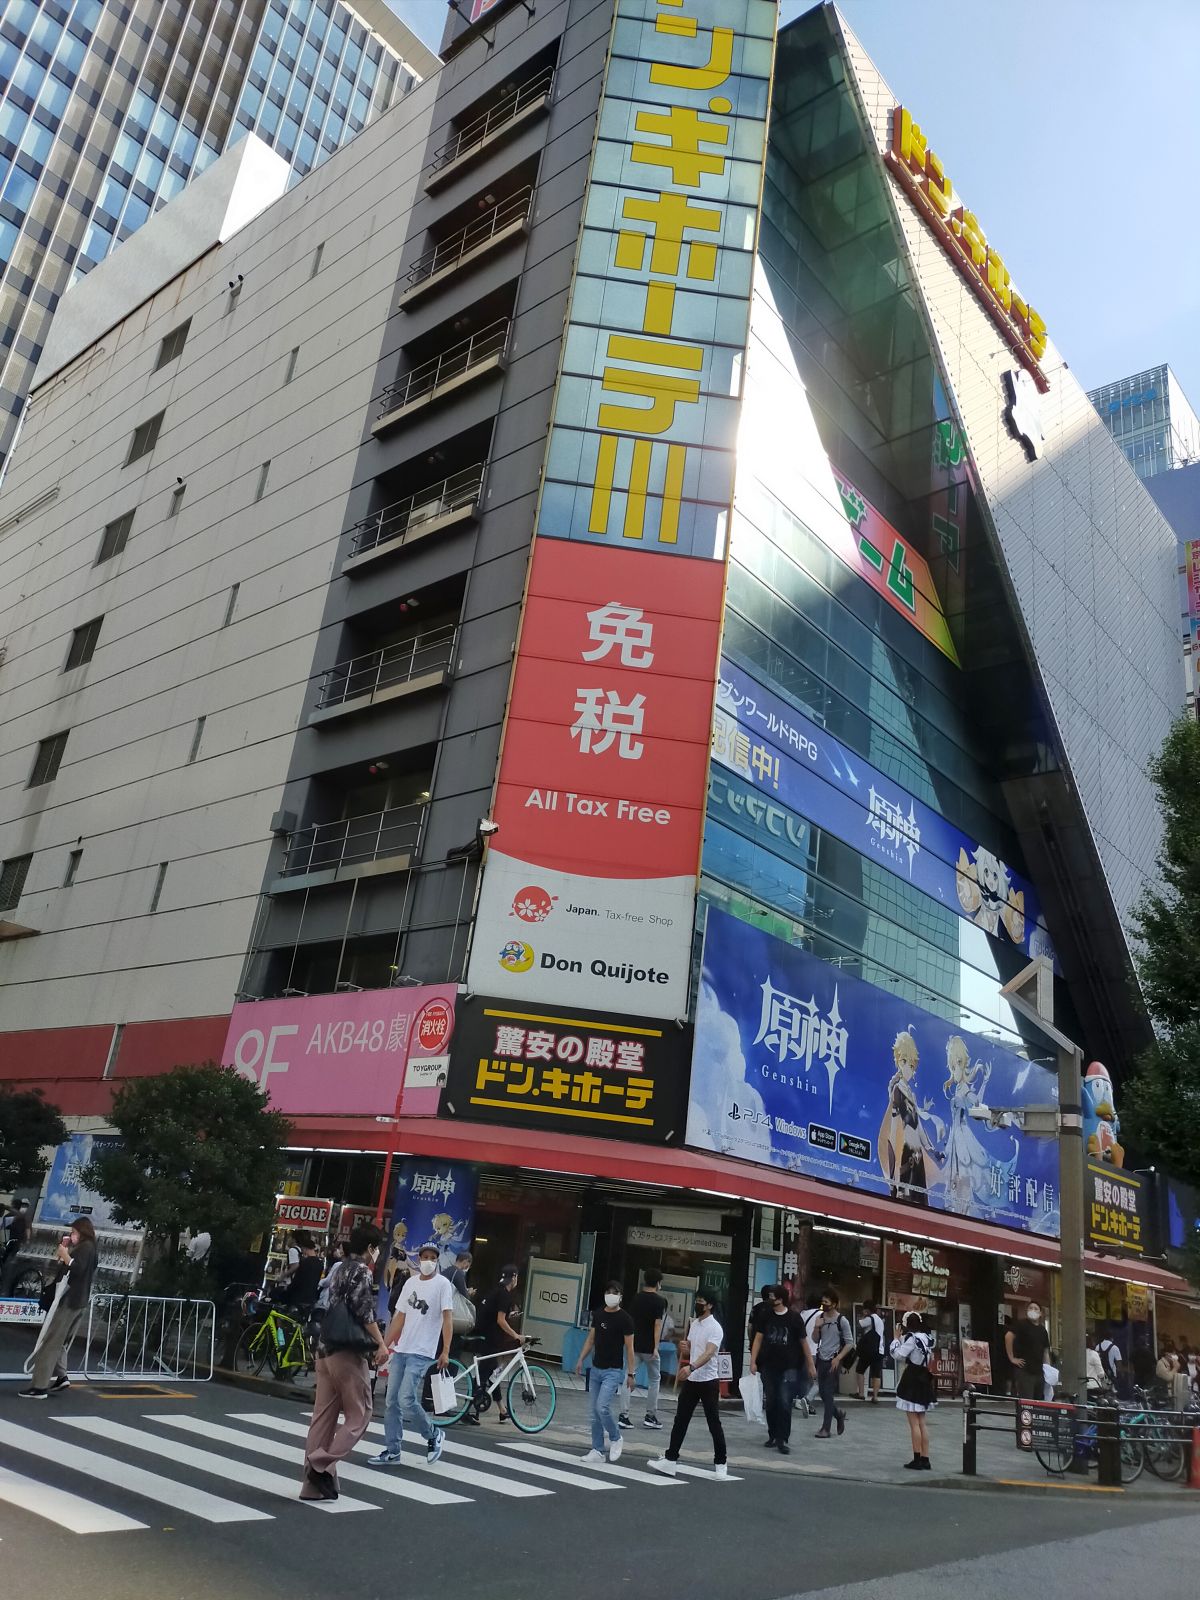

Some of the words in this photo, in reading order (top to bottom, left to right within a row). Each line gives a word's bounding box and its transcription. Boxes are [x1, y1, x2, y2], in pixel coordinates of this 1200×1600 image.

[570, 601, 655, 760] 免税
[525, 789, 558, 810] All
[566, 793, 608, 816] Tax
[617, 800, 671, 825] Free
[870, 837, 904, 864] Genshin
[605, 909, 644, 923] Tax-free
[648, 914, 674, 927] Shop
[540, 952, 583, 973] Don
[590, 960, 670, 985] Quijote
[306, 1011, 419, 1056] AKB48劇
[421, 1019, 446, 1036] 消火栓
[494, 1025, 645, 1072] 驚安の殿堂
[761, 1064, 818, 1095] Genshin
[775, 1116, 807, 1140] Windows
[279, 1204, 327, 1222] FIGURE
[784, 1213, 800, 1280] 牛串
[539, 1290, 568, 1303] IQOS
